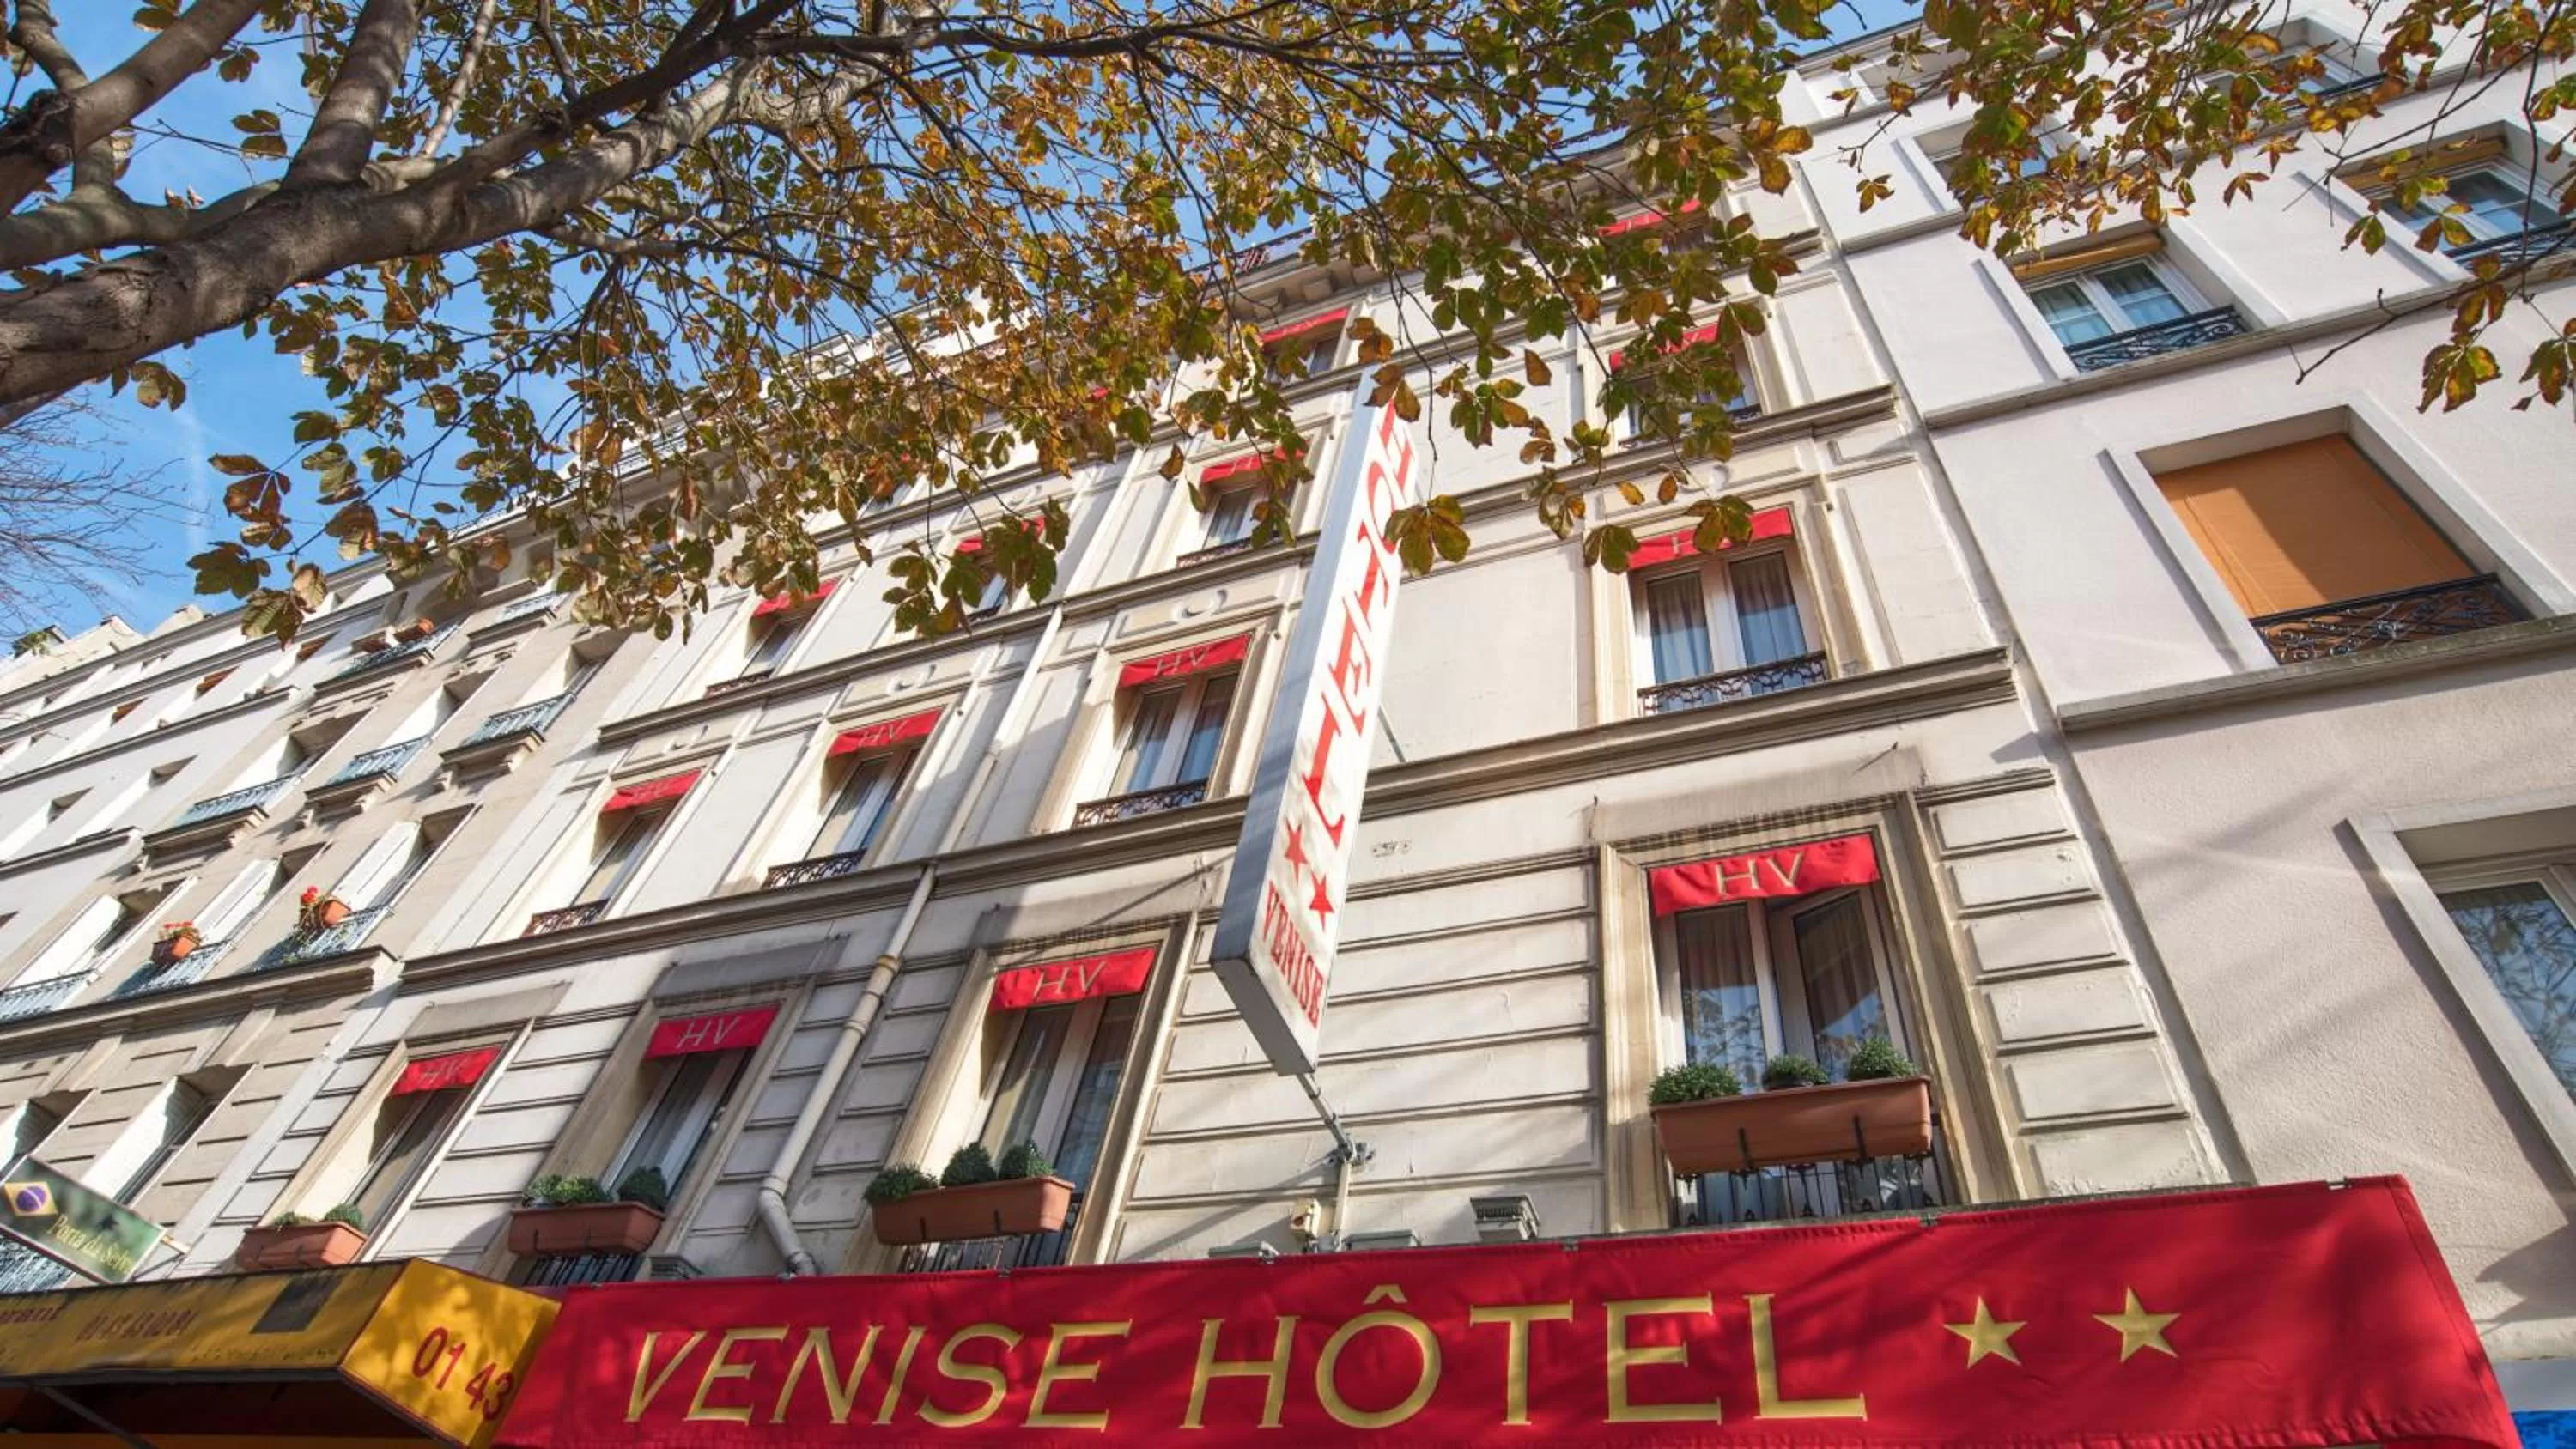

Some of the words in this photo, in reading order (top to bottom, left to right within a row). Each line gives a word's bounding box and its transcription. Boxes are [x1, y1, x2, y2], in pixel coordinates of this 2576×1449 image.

[1303, 397, 1414, 850] HOTEL
[1153, 645, 1211, 677] HV
[859, 719, 910, 747] HV
[1714, 851, 1803, 896] HV
[1263, 879, 1324, 1030] VENISE
[1032, 961, 1108, 1002] HV
[676, 1016, 741, 1049] HV
[411, 1326, 468, 1391] 01
[465, 1361, 514, 1421] 43
[623, 1318, 1133, 1433] VENISE
[1179, 1284, 1868, 1429] HÔTEL
